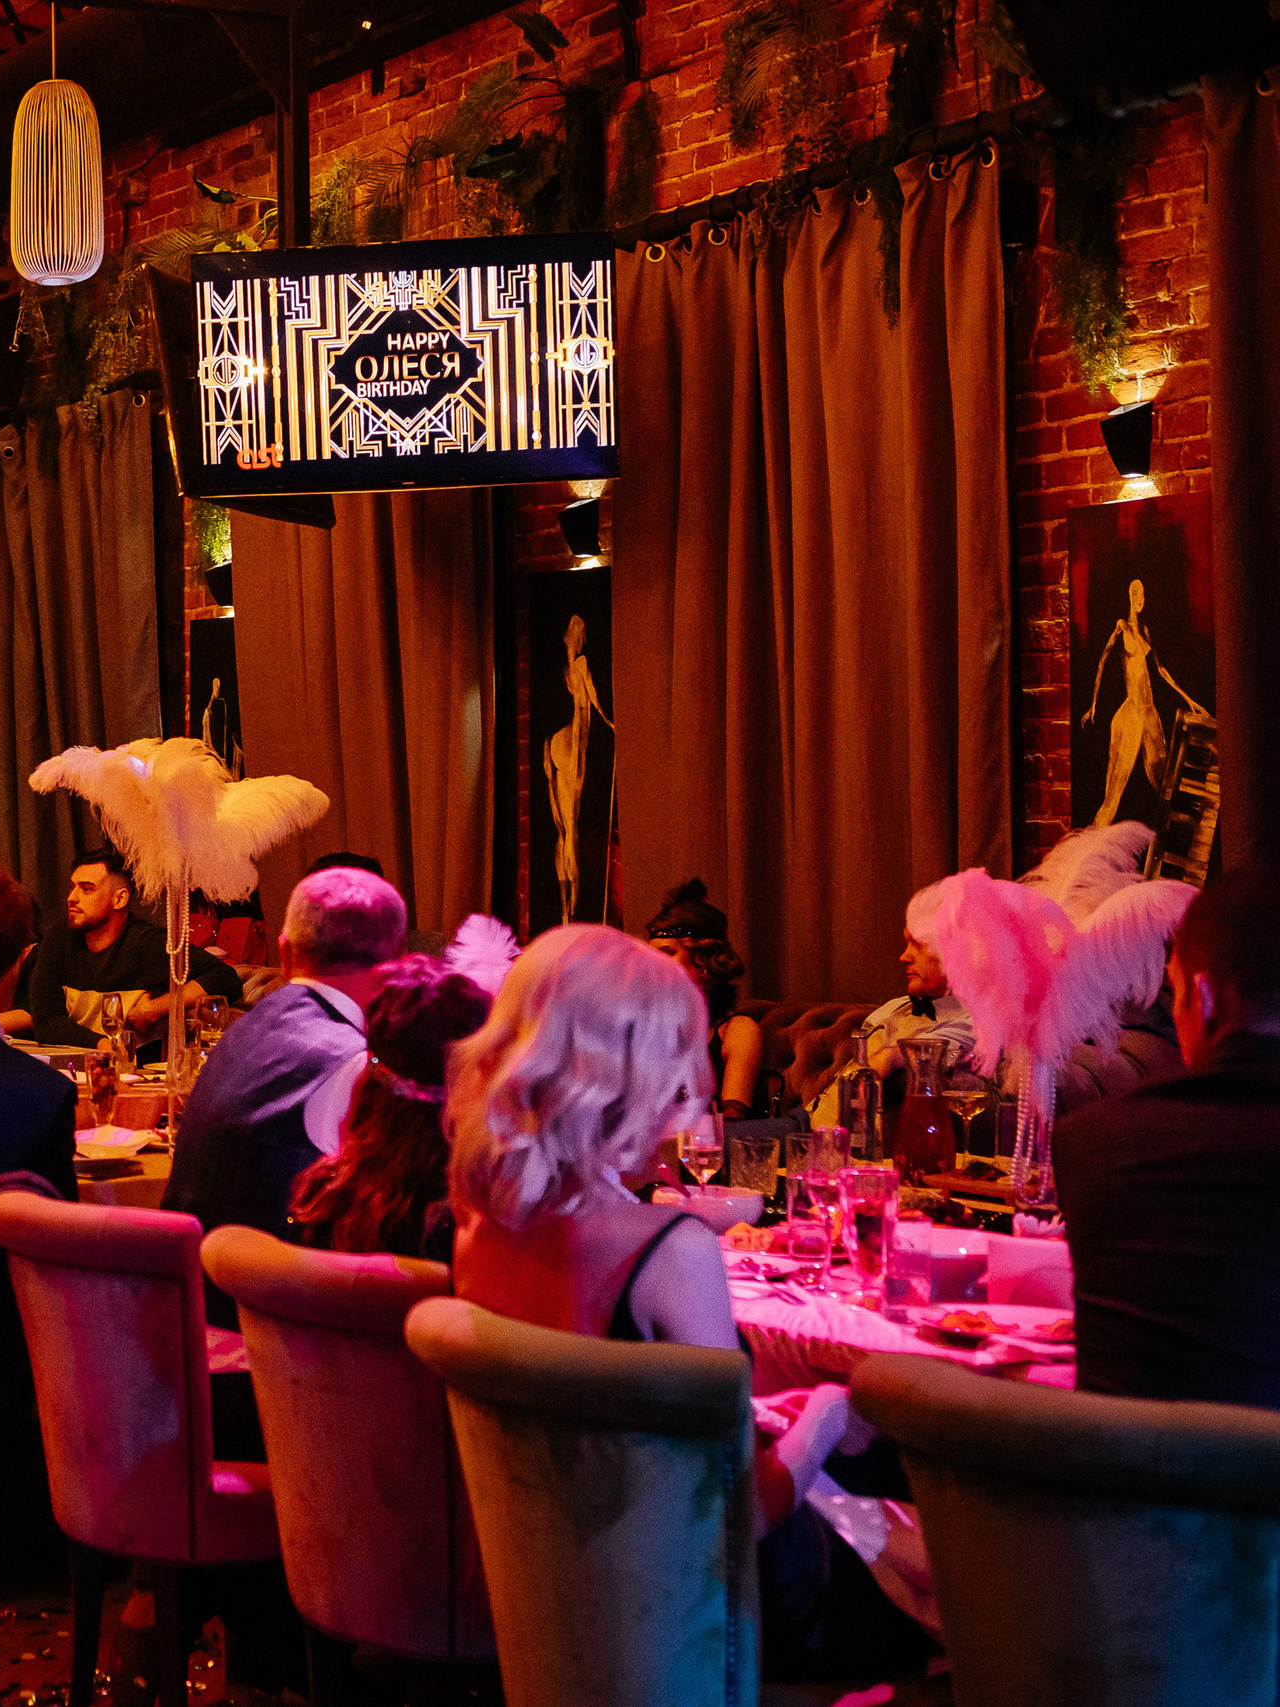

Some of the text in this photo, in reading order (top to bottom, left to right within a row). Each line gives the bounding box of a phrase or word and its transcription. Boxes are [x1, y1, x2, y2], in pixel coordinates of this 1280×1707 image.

[387, 331, 450, 351] HAPPY
[354, 351, 461, 382] ОЛЕСЯ
[356, 379, 431, 398] BIRTHDAY
